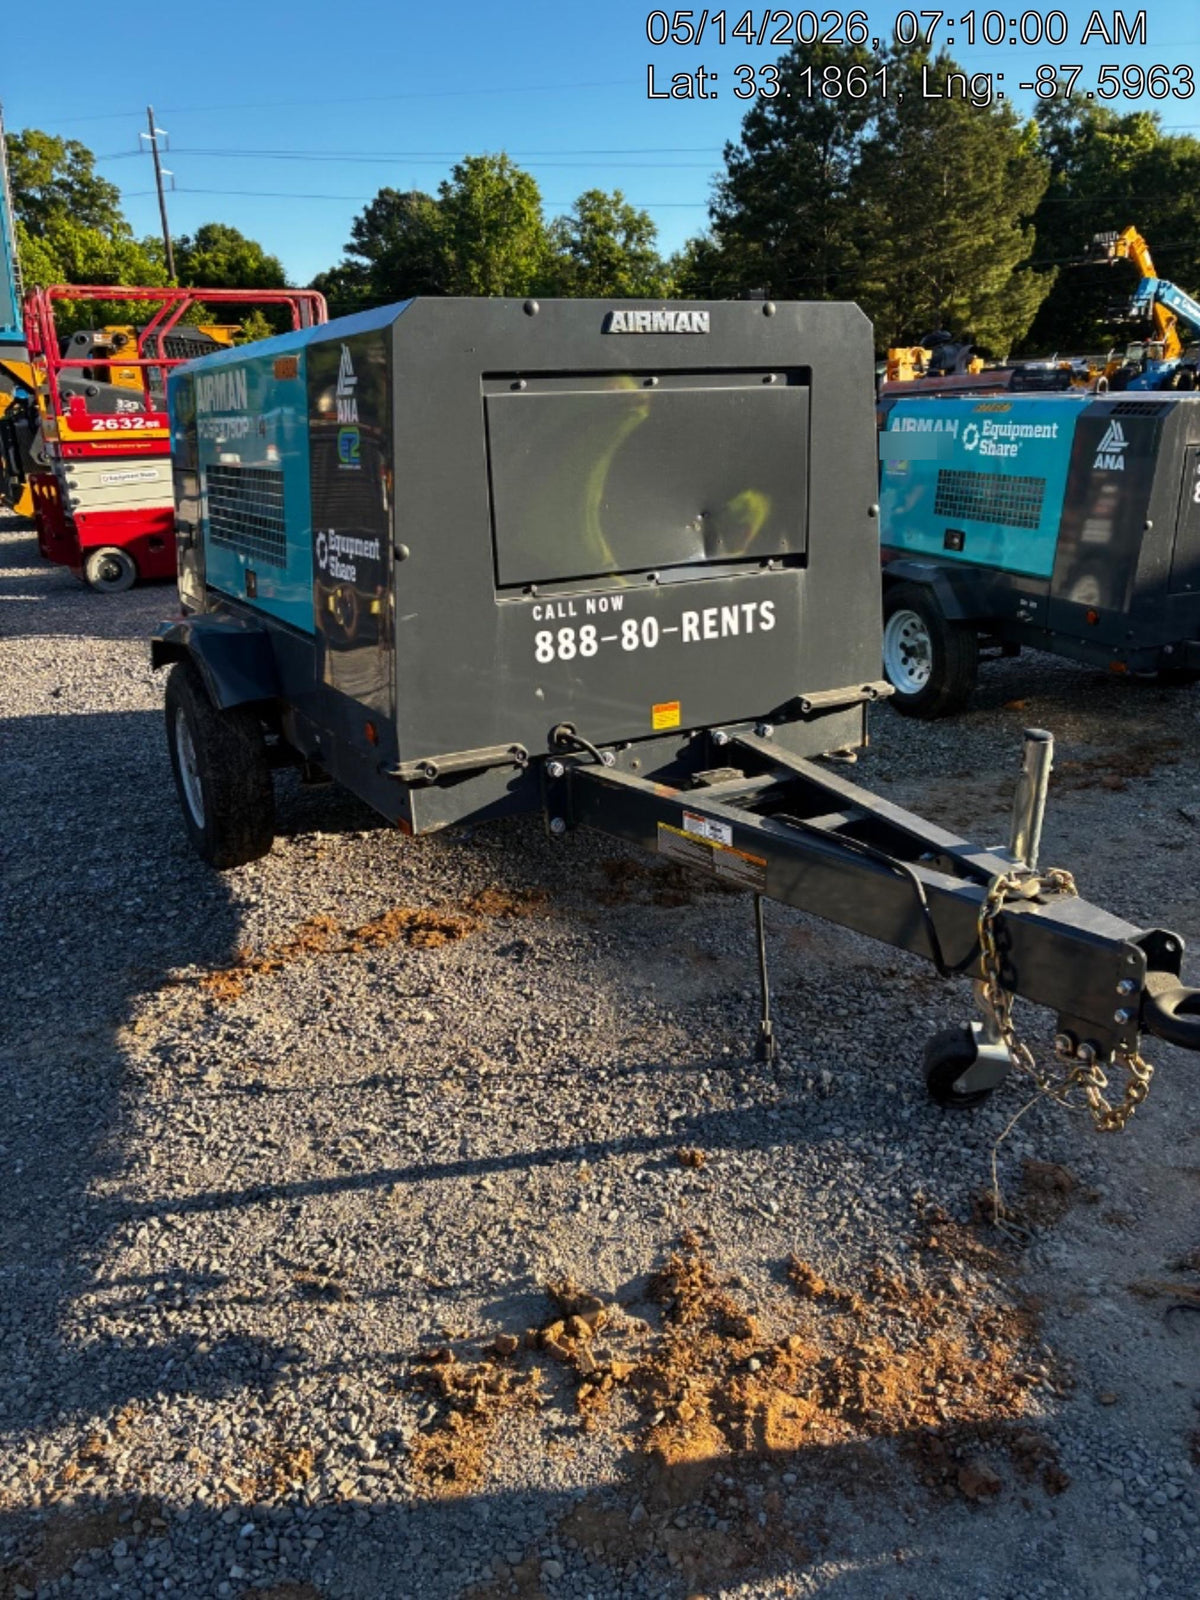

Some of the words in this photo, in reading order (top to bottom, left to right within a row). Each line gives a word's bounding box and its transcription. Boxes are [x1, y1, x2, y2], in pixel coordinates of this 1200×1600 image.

[606, 311, 710, 334] AIRMAN
[196, 368, 248, 413] AIRMAN
[982, 419, 1058, 441] Equipment
[979, 439, 1019, 457] Share
[1093, 453, 1125, 471] ANA
[328, 528, 380, 560] Equipment
[329, 556, 357, 582] Share
[532, 600, 578, 621] CALL
[586, 595, 624, 614] NOW
[534, 600, 776, 664] 888-80-RENTS
